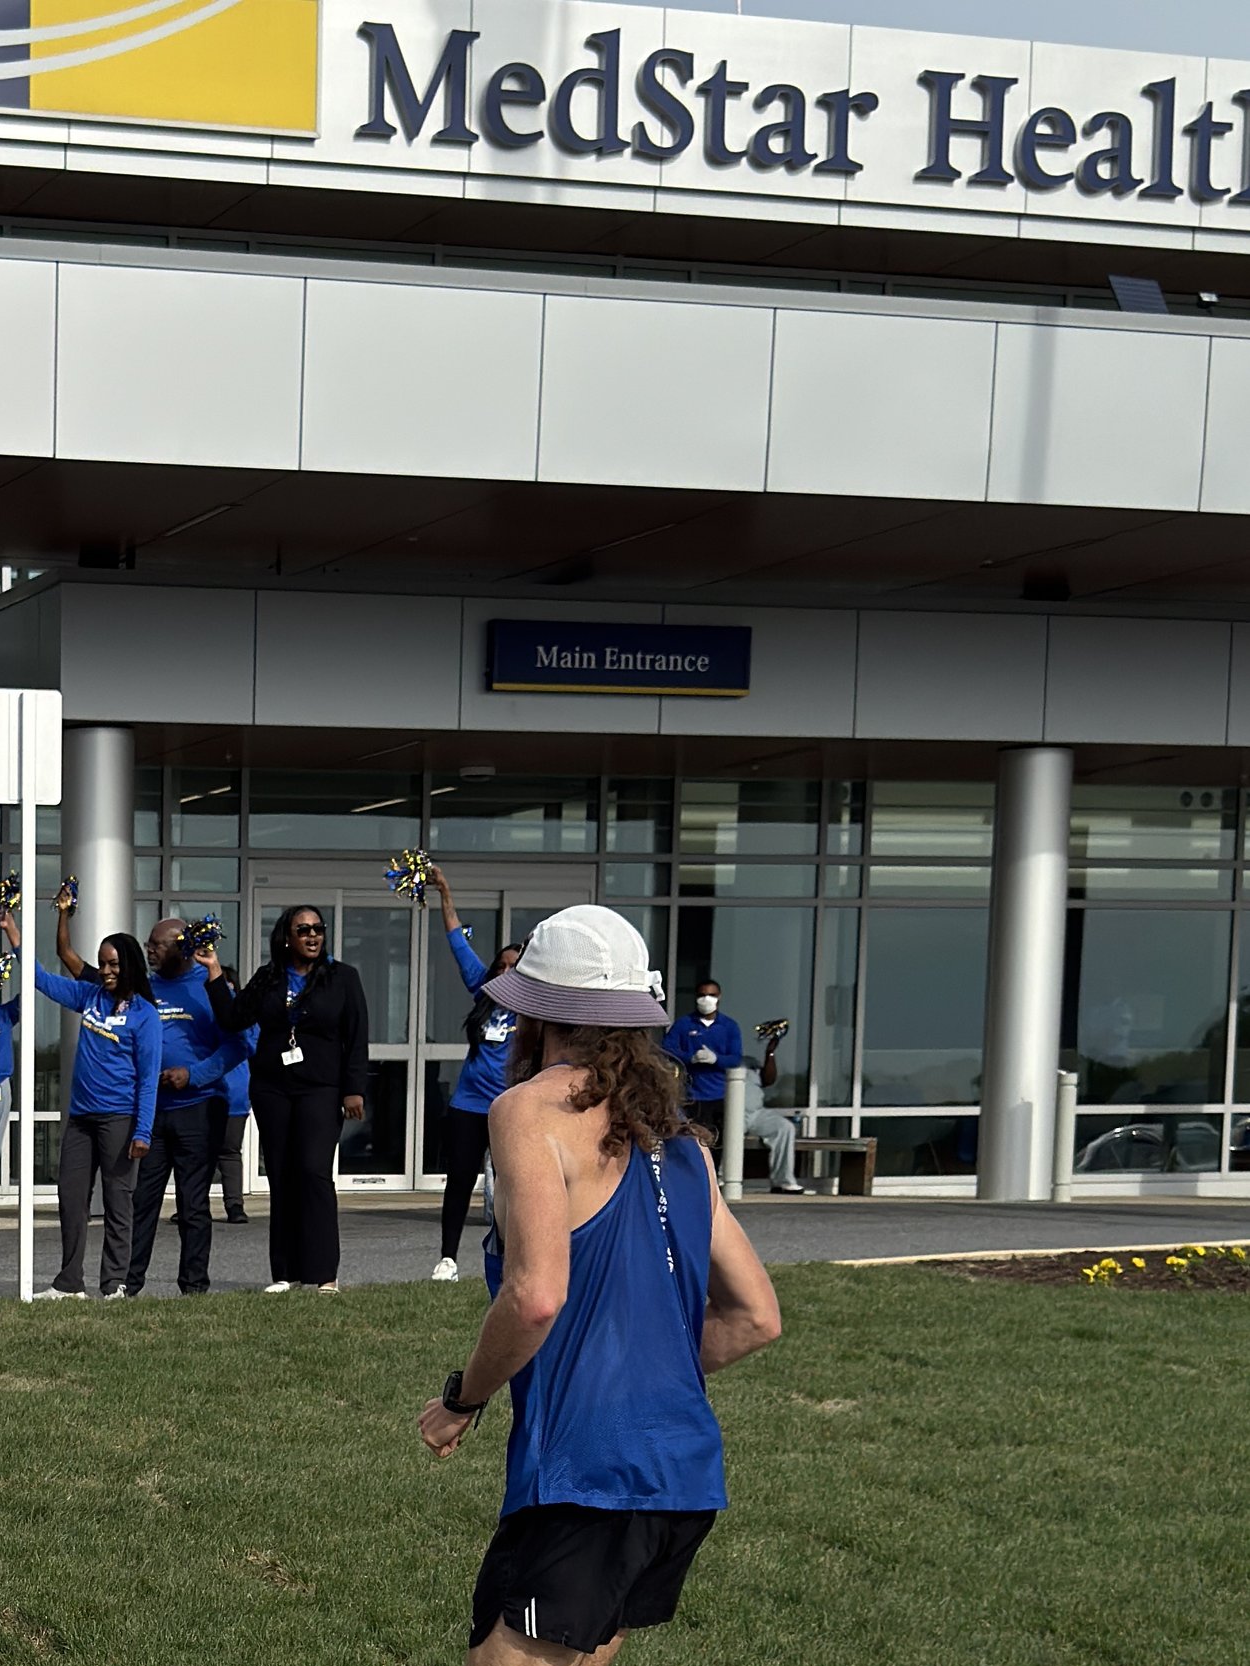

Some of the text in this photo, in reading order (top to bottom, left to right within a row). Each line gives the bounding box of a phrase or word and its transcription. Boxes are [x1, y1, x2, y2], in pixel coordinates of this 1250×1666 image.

[356, 21, 879, 176] MedStar
[537, 646, 709, 672] Main Entrance
